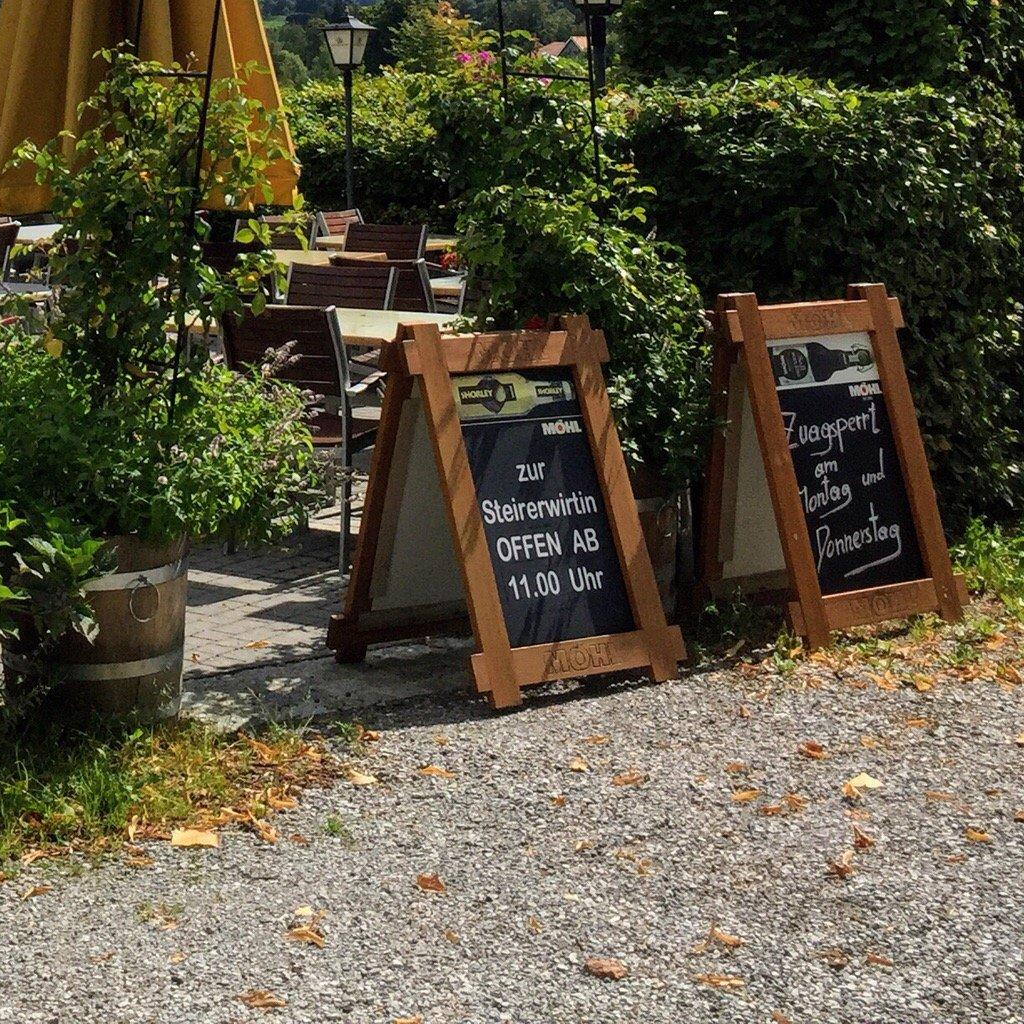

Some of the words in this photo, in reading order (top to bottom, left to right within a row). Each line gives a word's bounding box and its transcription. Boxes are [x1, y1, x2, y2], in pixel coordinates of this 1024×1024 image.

[516, 462, 545, 482] zur
[814, 460, 838, 478] am
[862, 448, 886, 486] und
[482, 491, 597, 524] Steirerwirtin
[497, 532, 562, 562] OFFEN
[573, 528, 599, 554] AB
[816, 502, 902, 577] Donnerstag
[508, 571, 560, 600] 11.00
[569, 566, 604, 592] Uhr
